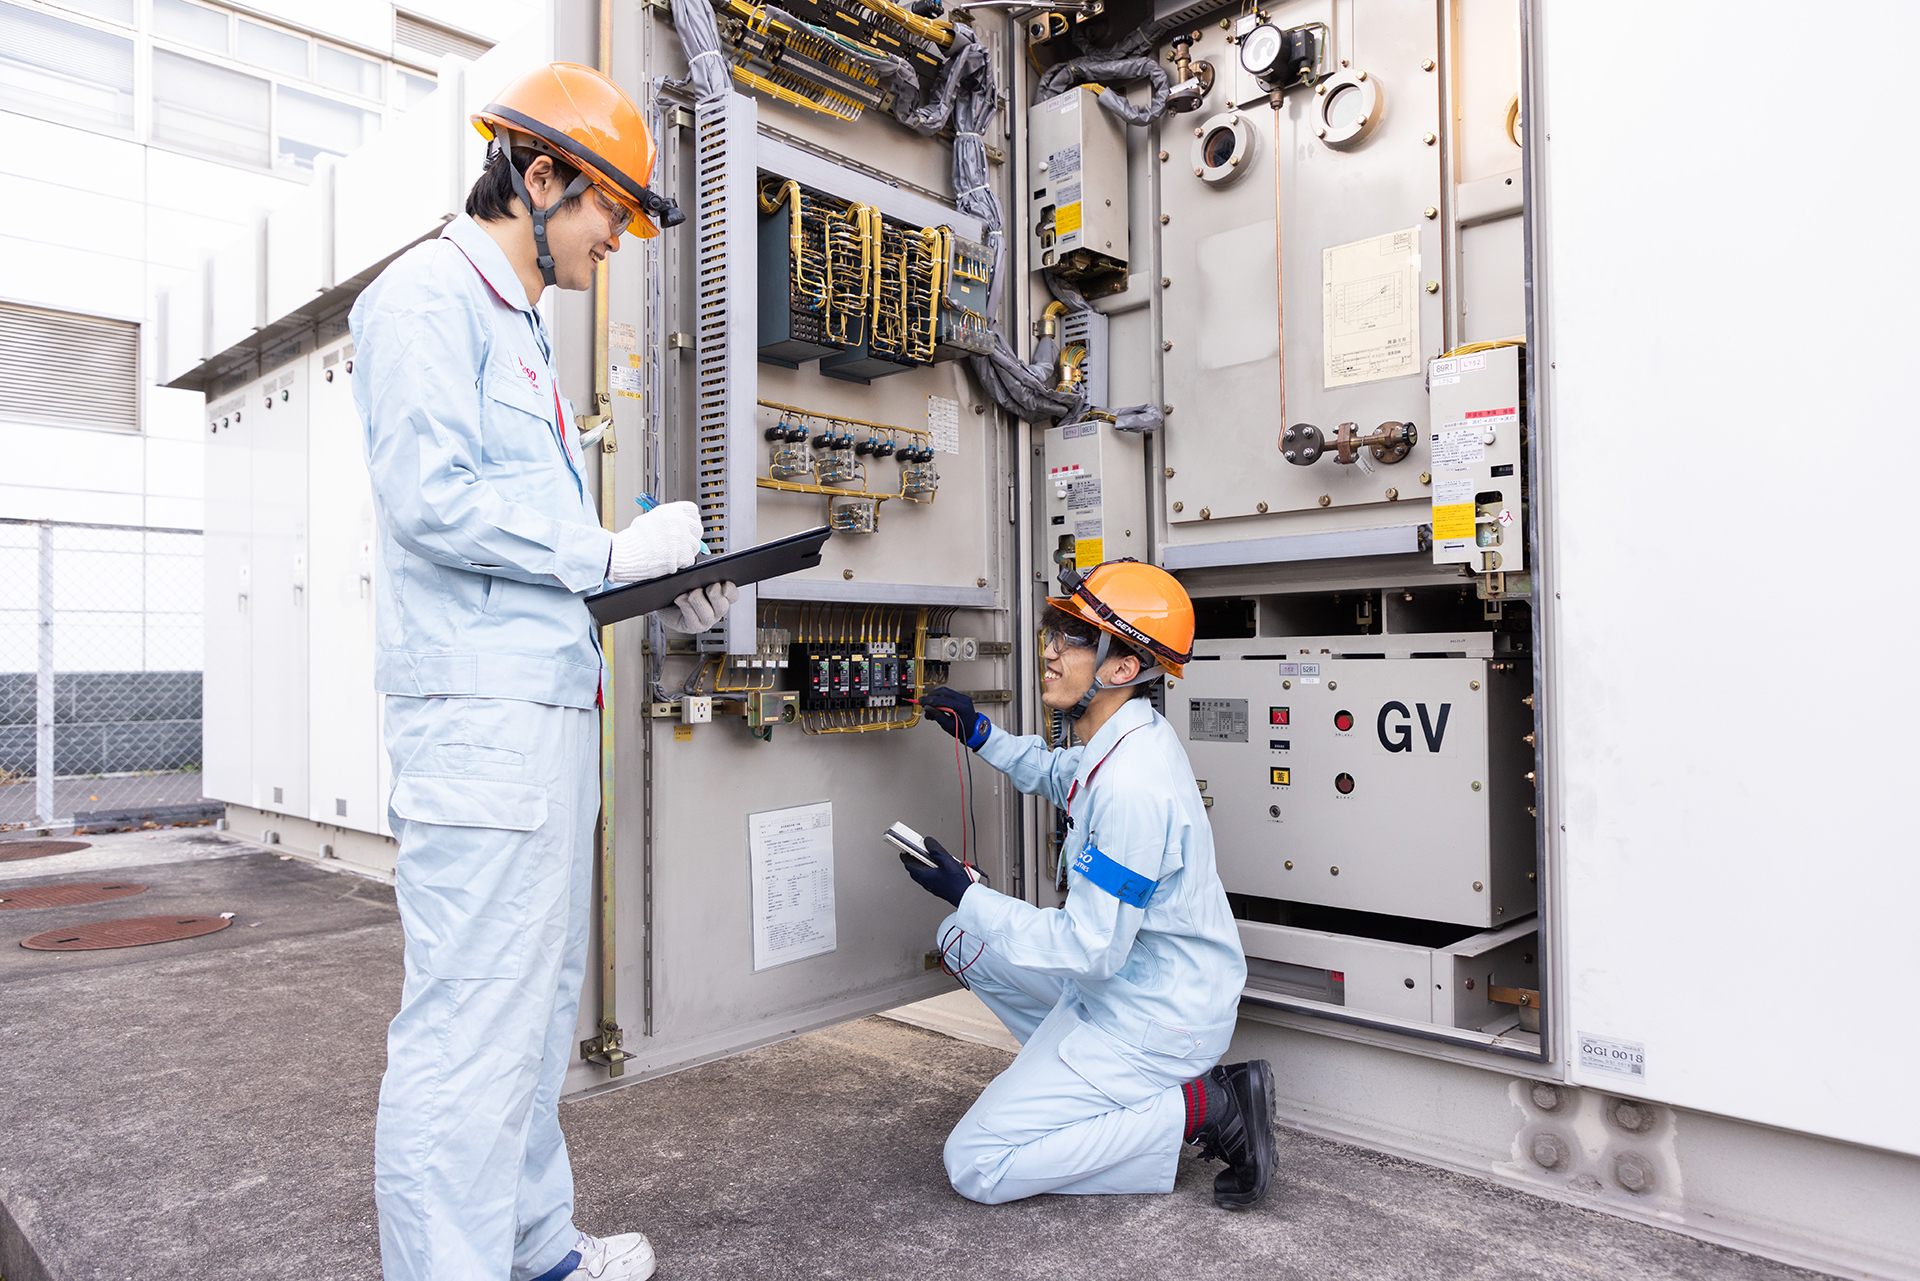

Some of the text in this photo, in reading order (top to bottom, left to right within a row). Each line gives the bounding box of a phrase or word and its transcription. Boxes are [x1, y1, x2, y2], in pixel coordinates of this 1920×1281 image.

[1436, 363, 1453, 373] 89R1
[1463, 359, 1481, 367] L752
[1503, 511, 1513, 523] 入
[1114, 619, 1151, 645] GENTOS
[1276, 712, 1284, 723] 入
[1377, 700, 1451, 753] GV
[1583, 1044, 1644, 1063] QGI 0018
